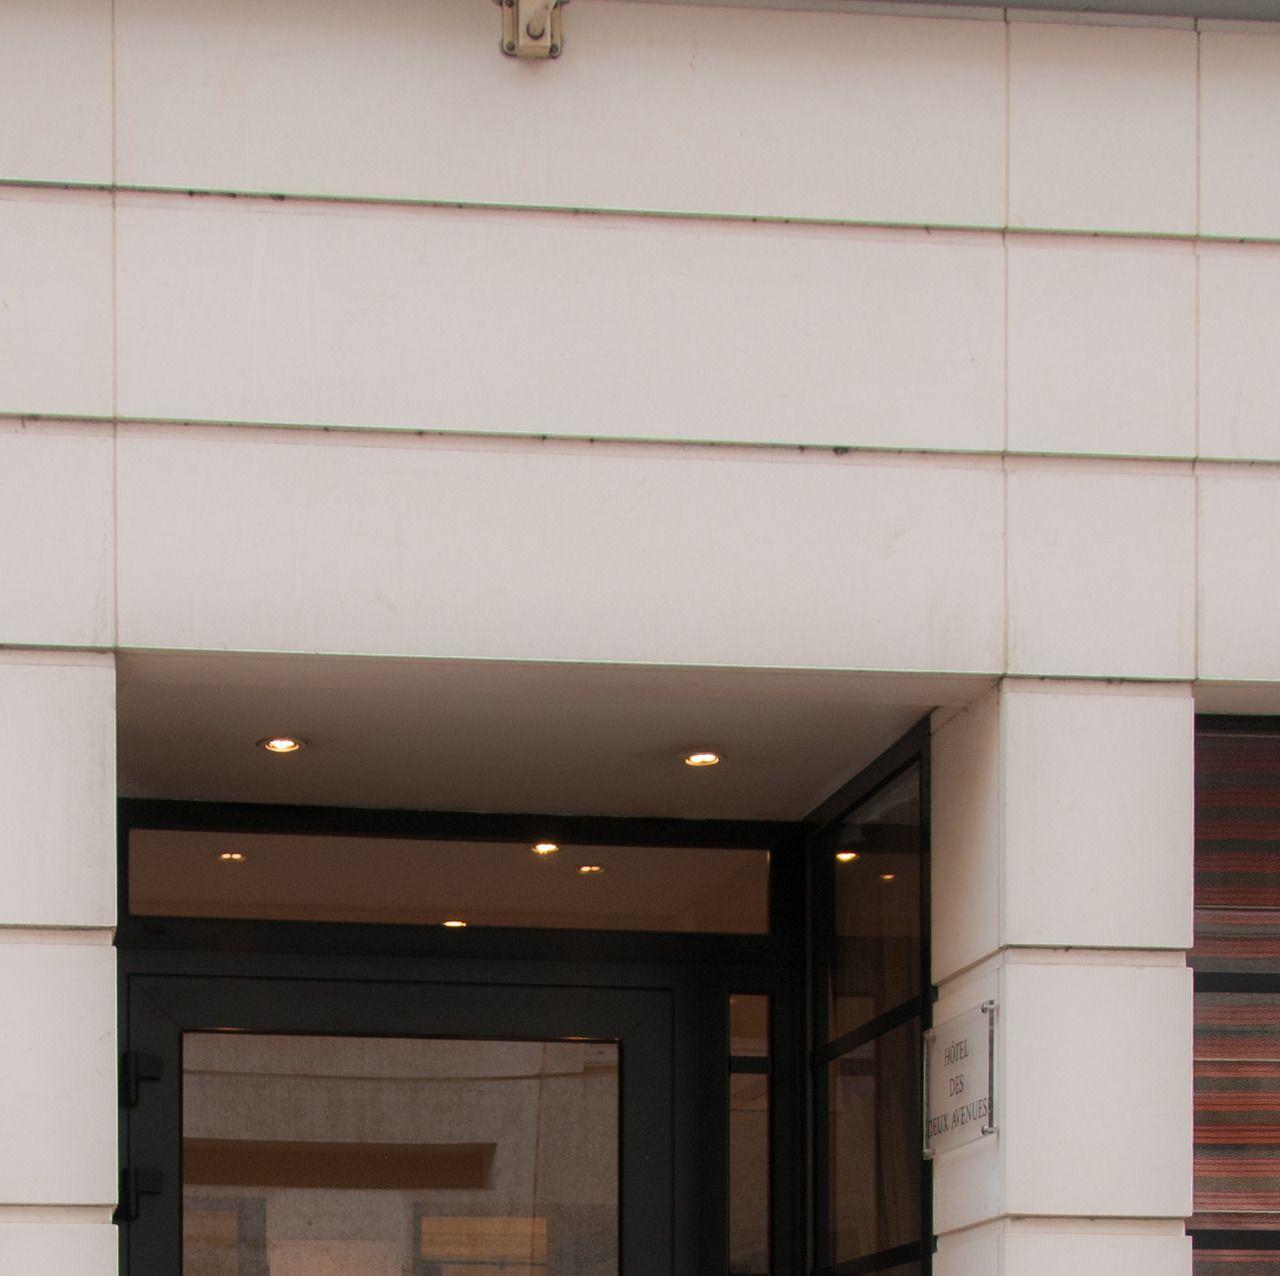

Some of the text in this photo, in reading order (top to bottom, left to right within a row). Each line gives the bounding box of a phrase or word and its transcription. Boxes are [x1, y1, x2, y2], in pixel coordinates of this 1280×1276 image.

[943, 1038, 969, 1067] HÔTEL
[949, 1074, 965, 1098] DES
[927, 1097, 988, 1138] DEUX AVENUES
